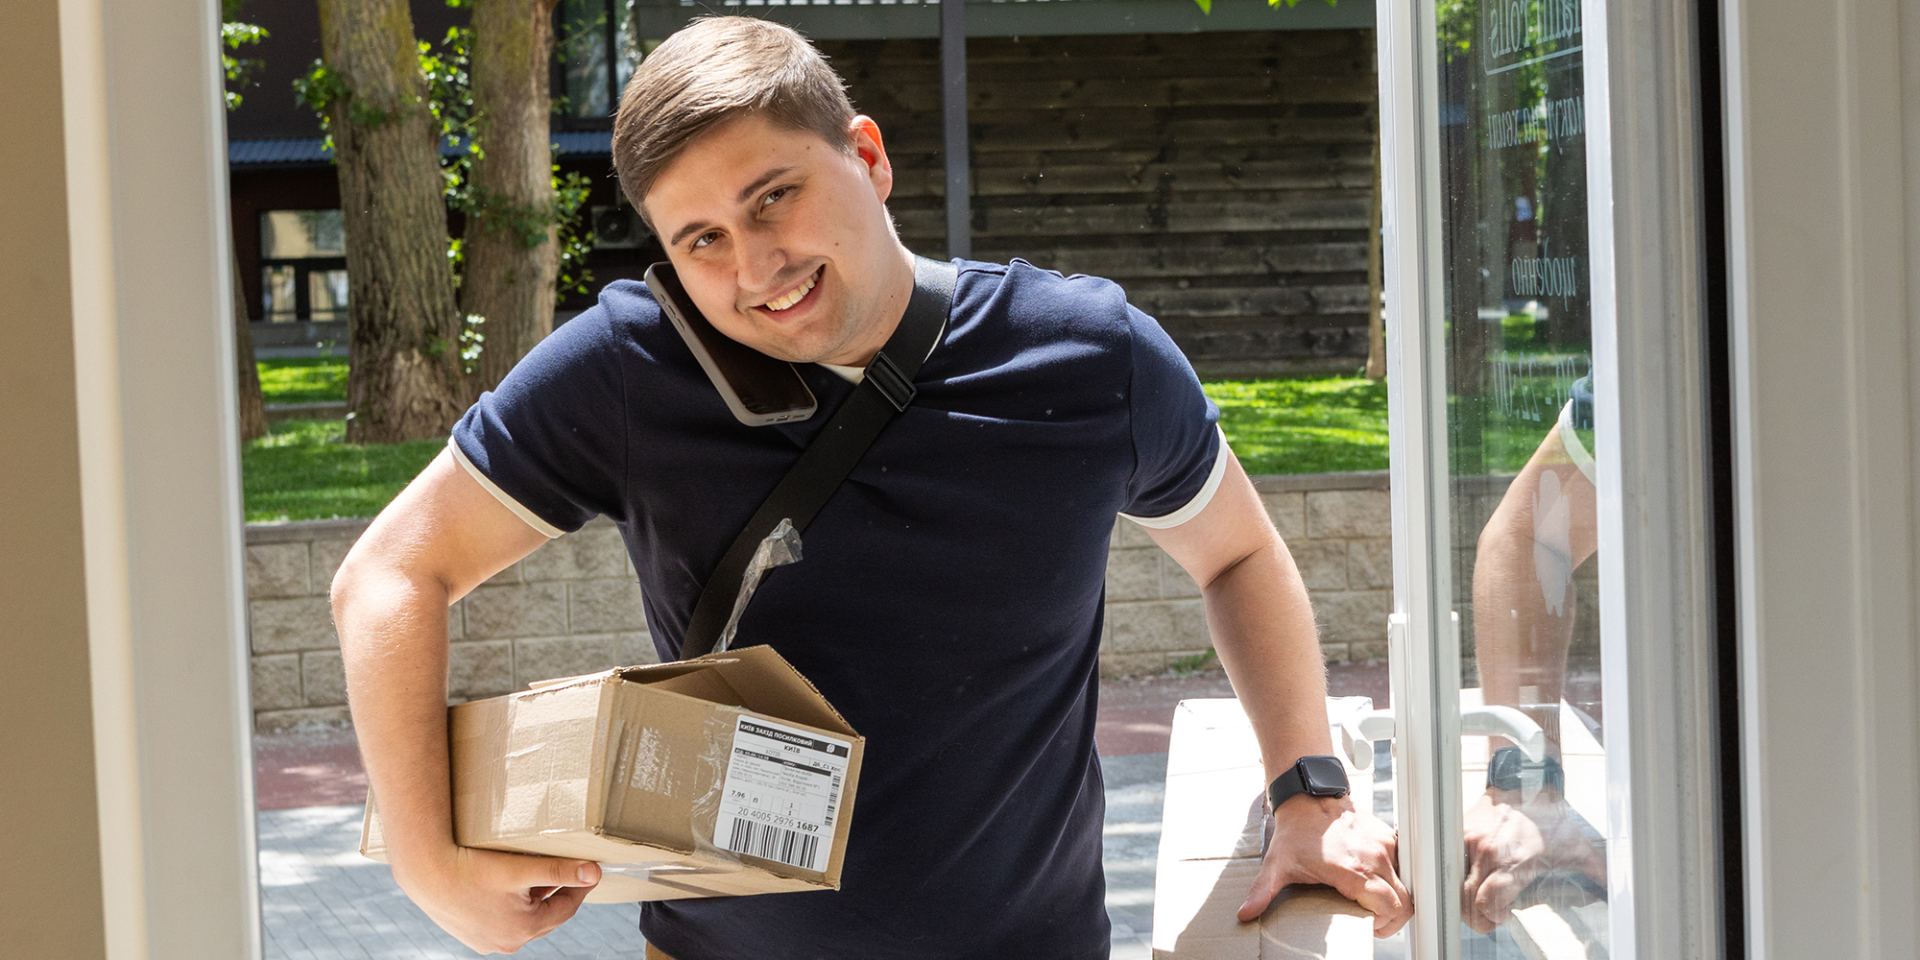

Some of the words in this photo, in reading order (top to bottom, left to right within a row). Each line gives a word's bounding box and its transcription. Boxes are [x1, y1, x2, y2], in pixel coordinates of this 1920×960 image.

[740, 723, 755, 732] КИЇВ
[755, 727, 774, 738] ЗАХІД
[774, 732, 813, 746] ПОСИЛКОВИЙ
[783, 745, 801, 754] КИЇВ
[731, 789, 746, 799] 7.96
[737, 806, 749, 816] 20
[751, 810, 772, 822] 4005
[773, 815, 794, 827] 2976
[796, 821, 819, 833] 1687
